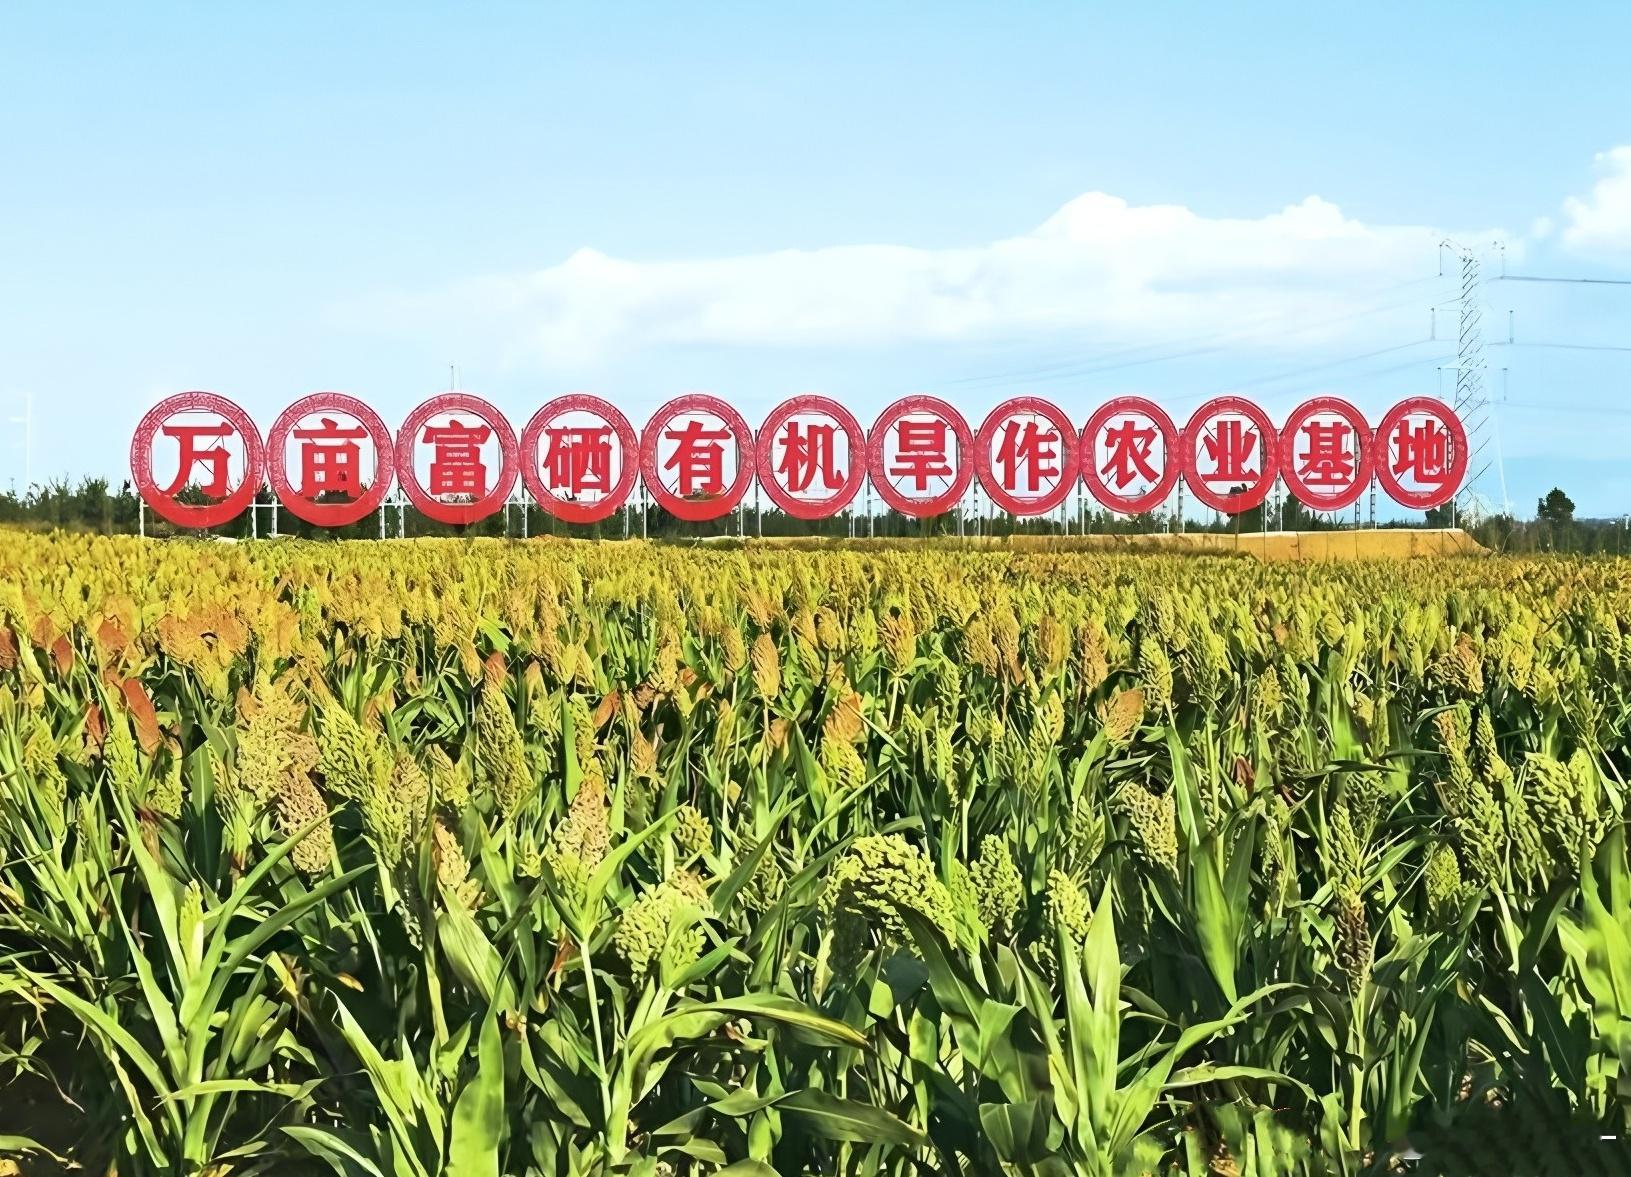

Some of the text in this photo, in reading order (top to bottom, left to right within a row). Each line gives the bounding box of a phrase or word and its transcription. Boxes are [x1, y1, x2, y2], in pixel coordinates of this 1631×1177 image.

[162, 418, 1453, 497] 万亩富硒有机旱作农业基地
